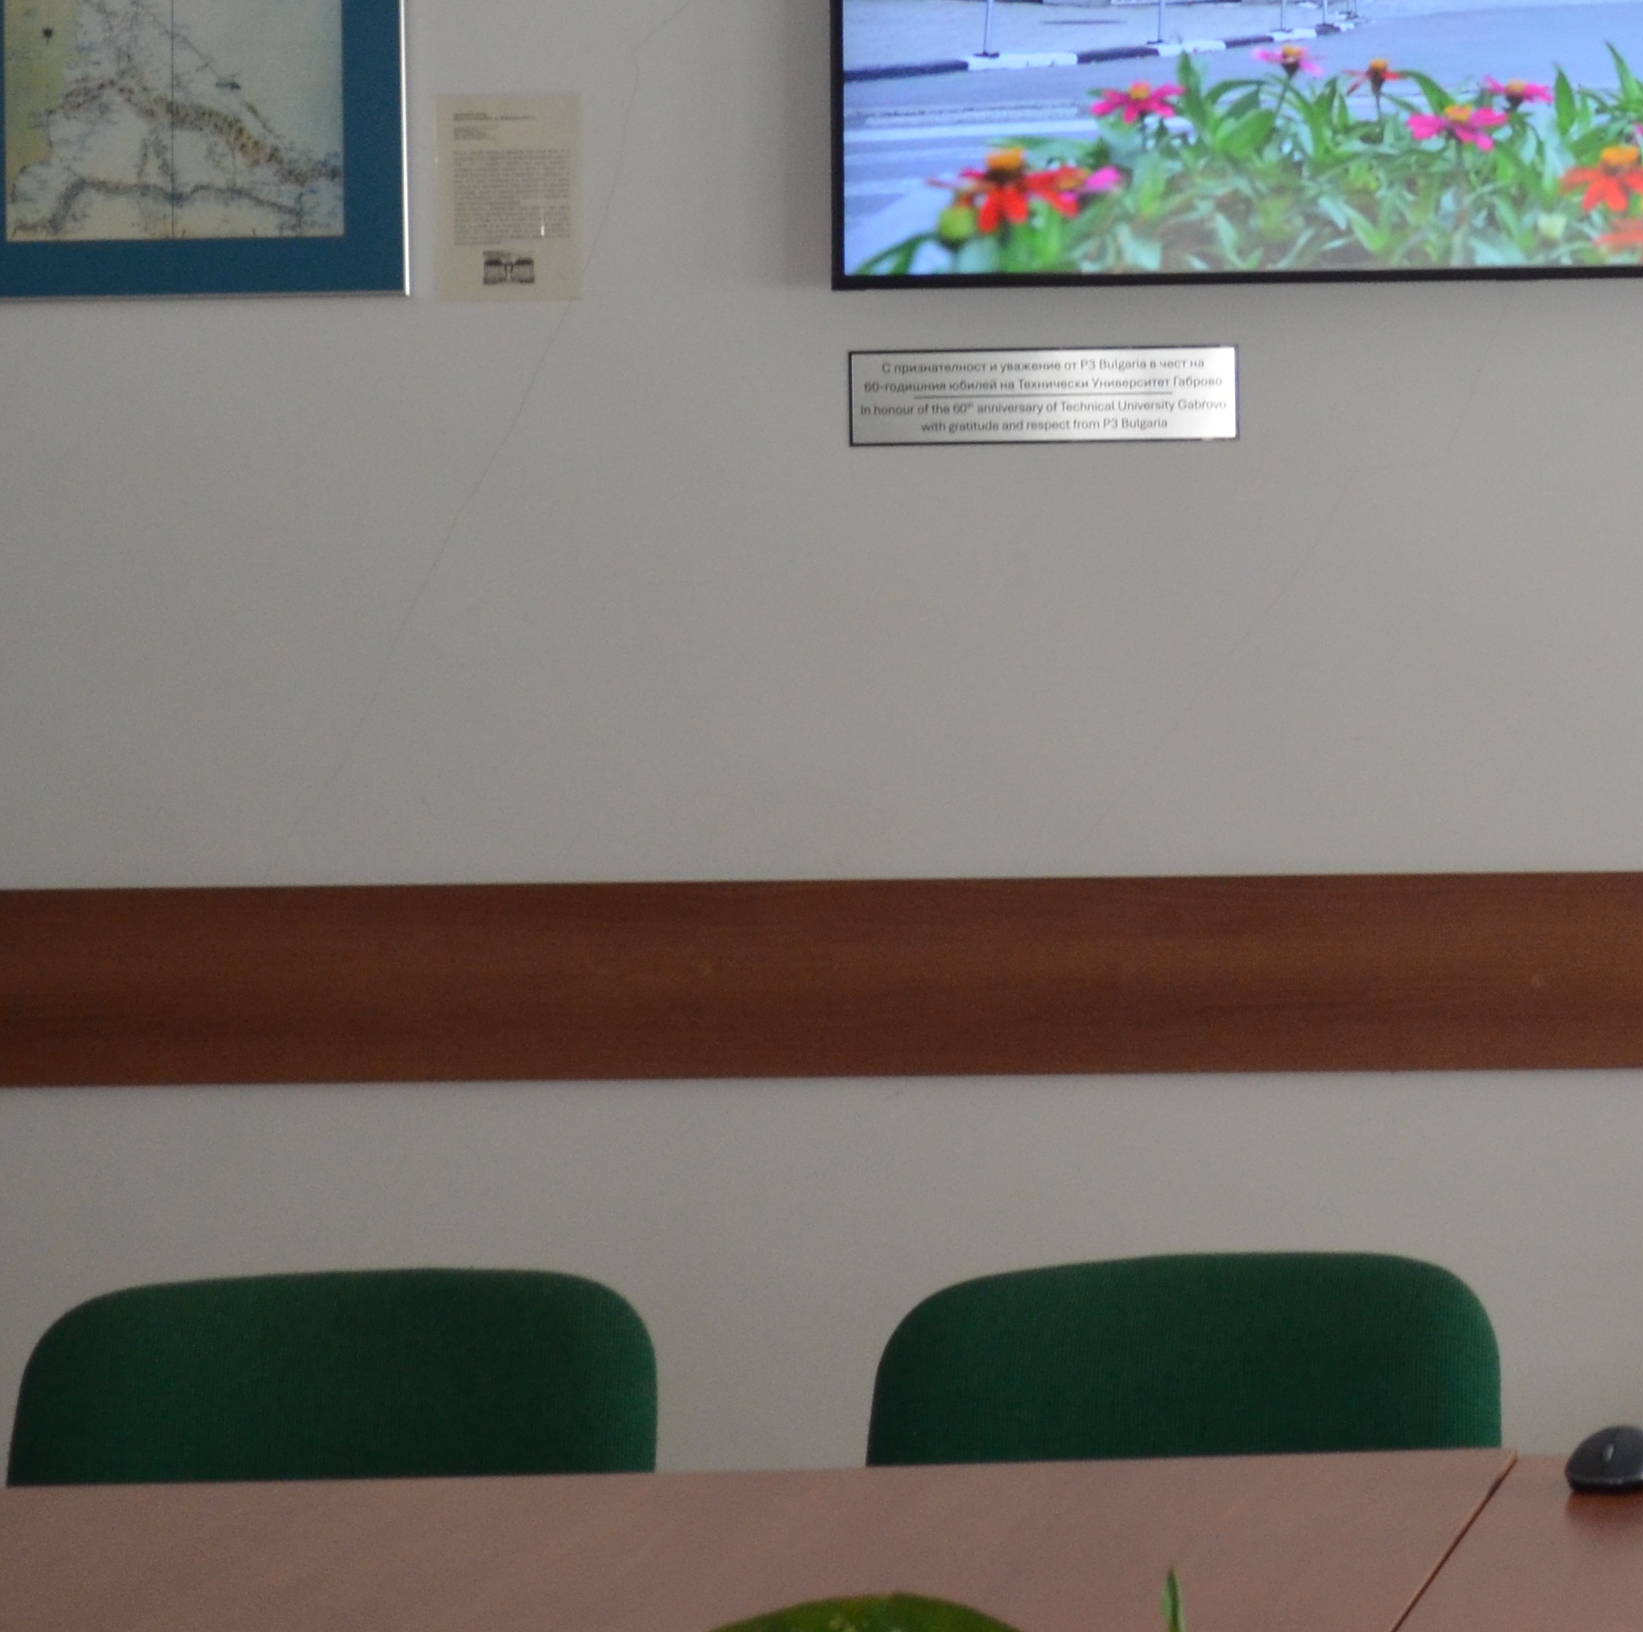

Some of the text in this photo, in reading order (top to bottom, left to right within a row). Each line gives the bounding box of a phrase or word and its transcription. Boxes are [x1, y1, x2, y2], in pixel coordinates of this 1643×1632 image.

[1099, 358, 1147, 372] Bulgaria
[873, 404, 914, 415] honour
[917, 403, 929, 415] of
[931, 403, 950, 414] the
[977, 402, 1043, 416] anniversary
[1046, 401, 1057, 413] of
[1061, 400, 1115, 413] Technical
[1117, 399, 1175, 413] University
[1177, 398, 1227, 411] Gabrovo
[921, 421, 946, 433] with
[948, 421, 999, 435] gratitude
[1002, 420, 1024, 432] and
[1026, 420, 1070, 433] respect
[1073, 418, 1100, 430] from
[1121, 418, 1168, 431] Bulgaria
